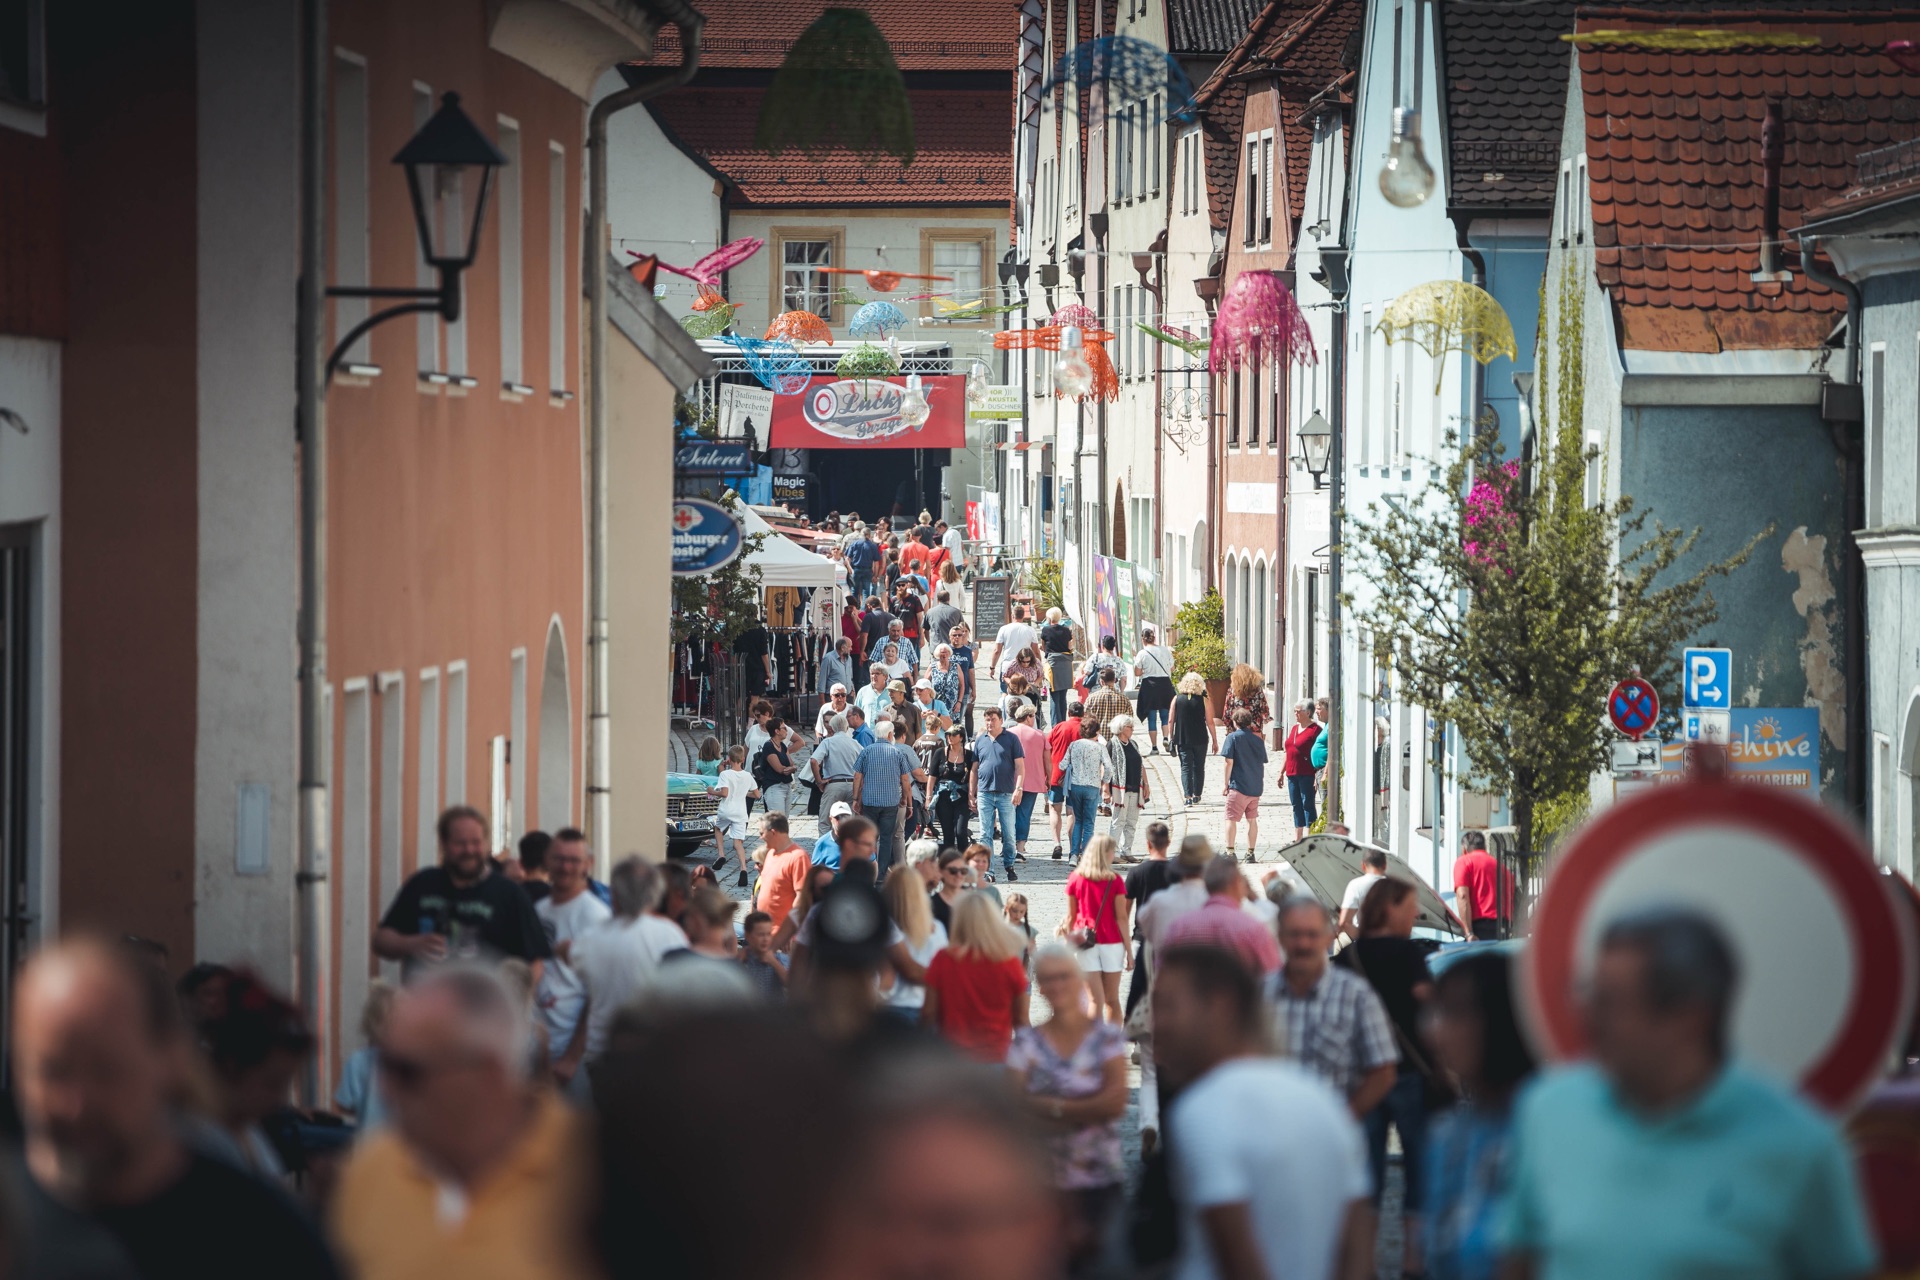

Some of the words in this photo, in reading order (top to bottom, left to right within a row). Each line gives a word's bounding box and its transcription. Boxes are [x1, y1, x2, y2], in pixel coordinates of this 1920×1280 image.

[735, 400, 769, 412] Porchetta
[855, 420, 902, 438] Garage
[675, 445, 745, 466] Seilerei
[774, 476, 806, 489] Magic
[774, 487, 806, 497] Vibes
[1691, 656, 1717, 702] P
